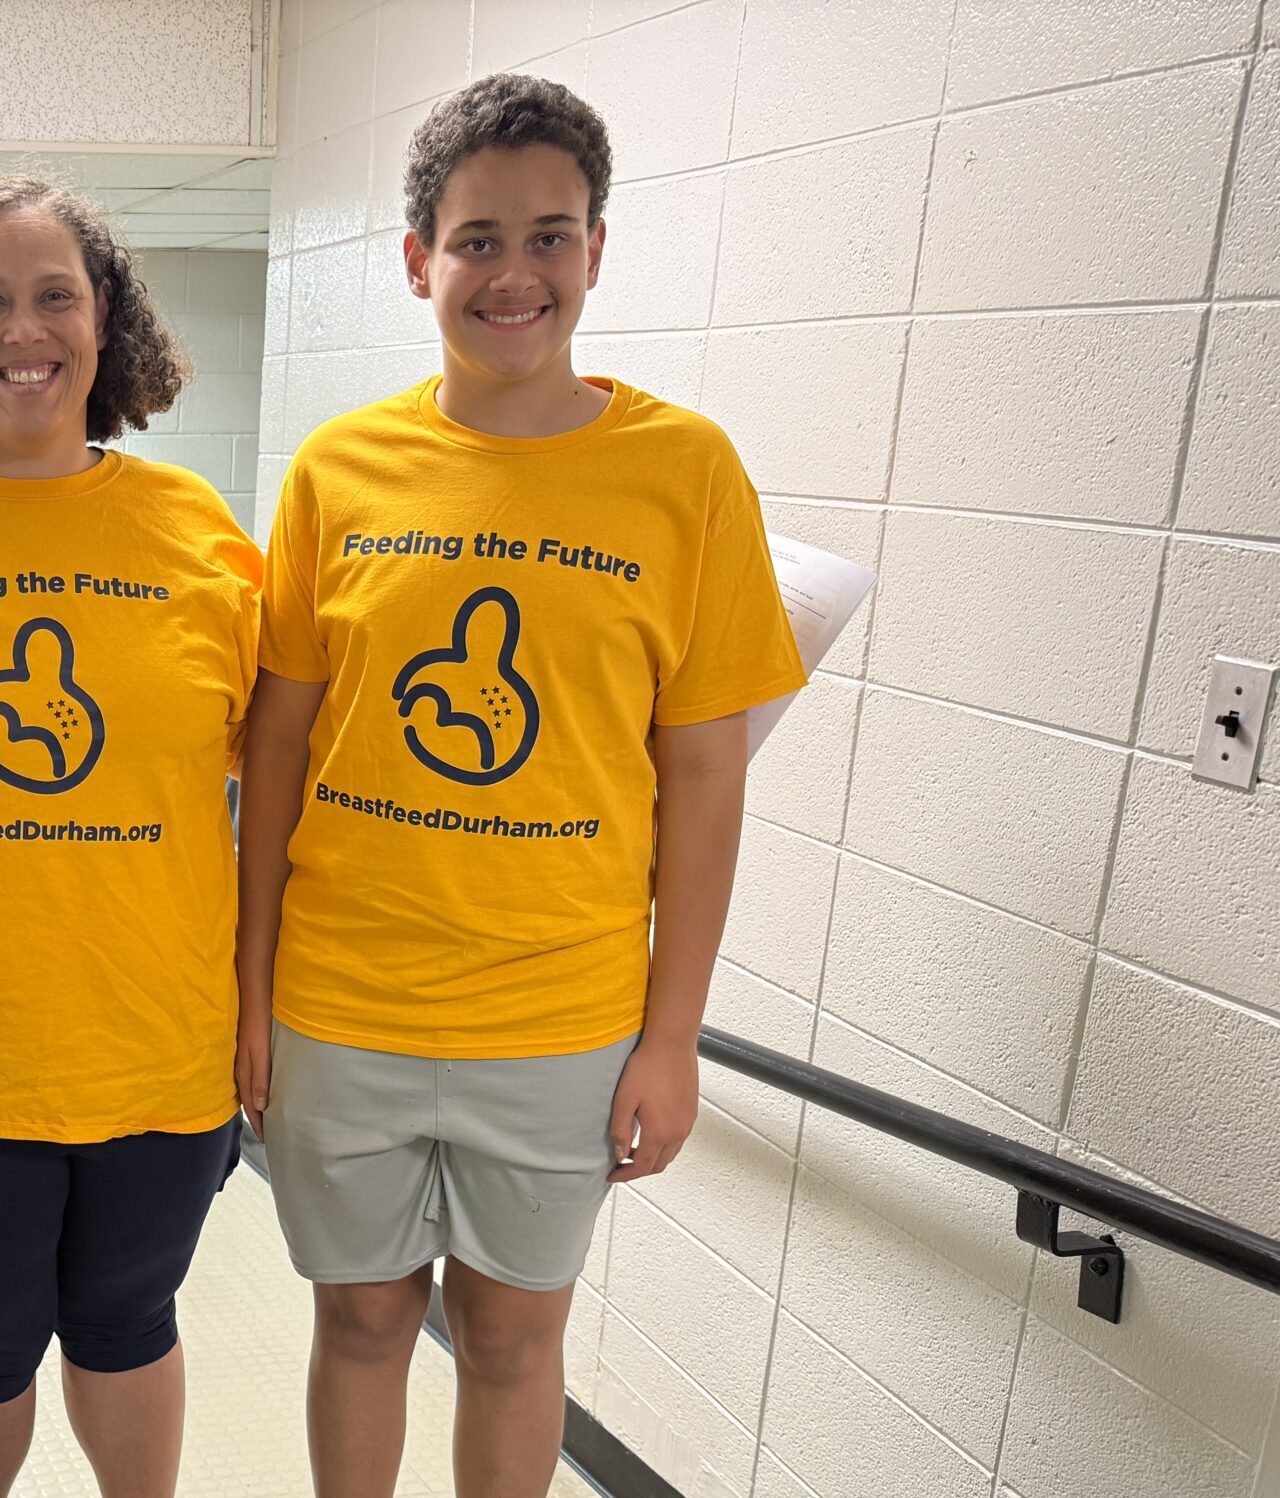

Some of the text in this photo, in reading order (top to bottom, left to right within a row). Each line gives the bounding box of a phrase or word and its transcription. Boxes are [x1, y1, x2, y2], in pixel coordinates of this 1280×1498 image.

[343, 531, 641, 583] Feeding the Future
[16, 572, 65, 593] the
[74, 573, 169, 600] Future
[316, 782, 600, 839] BreastfeedDurham.org
